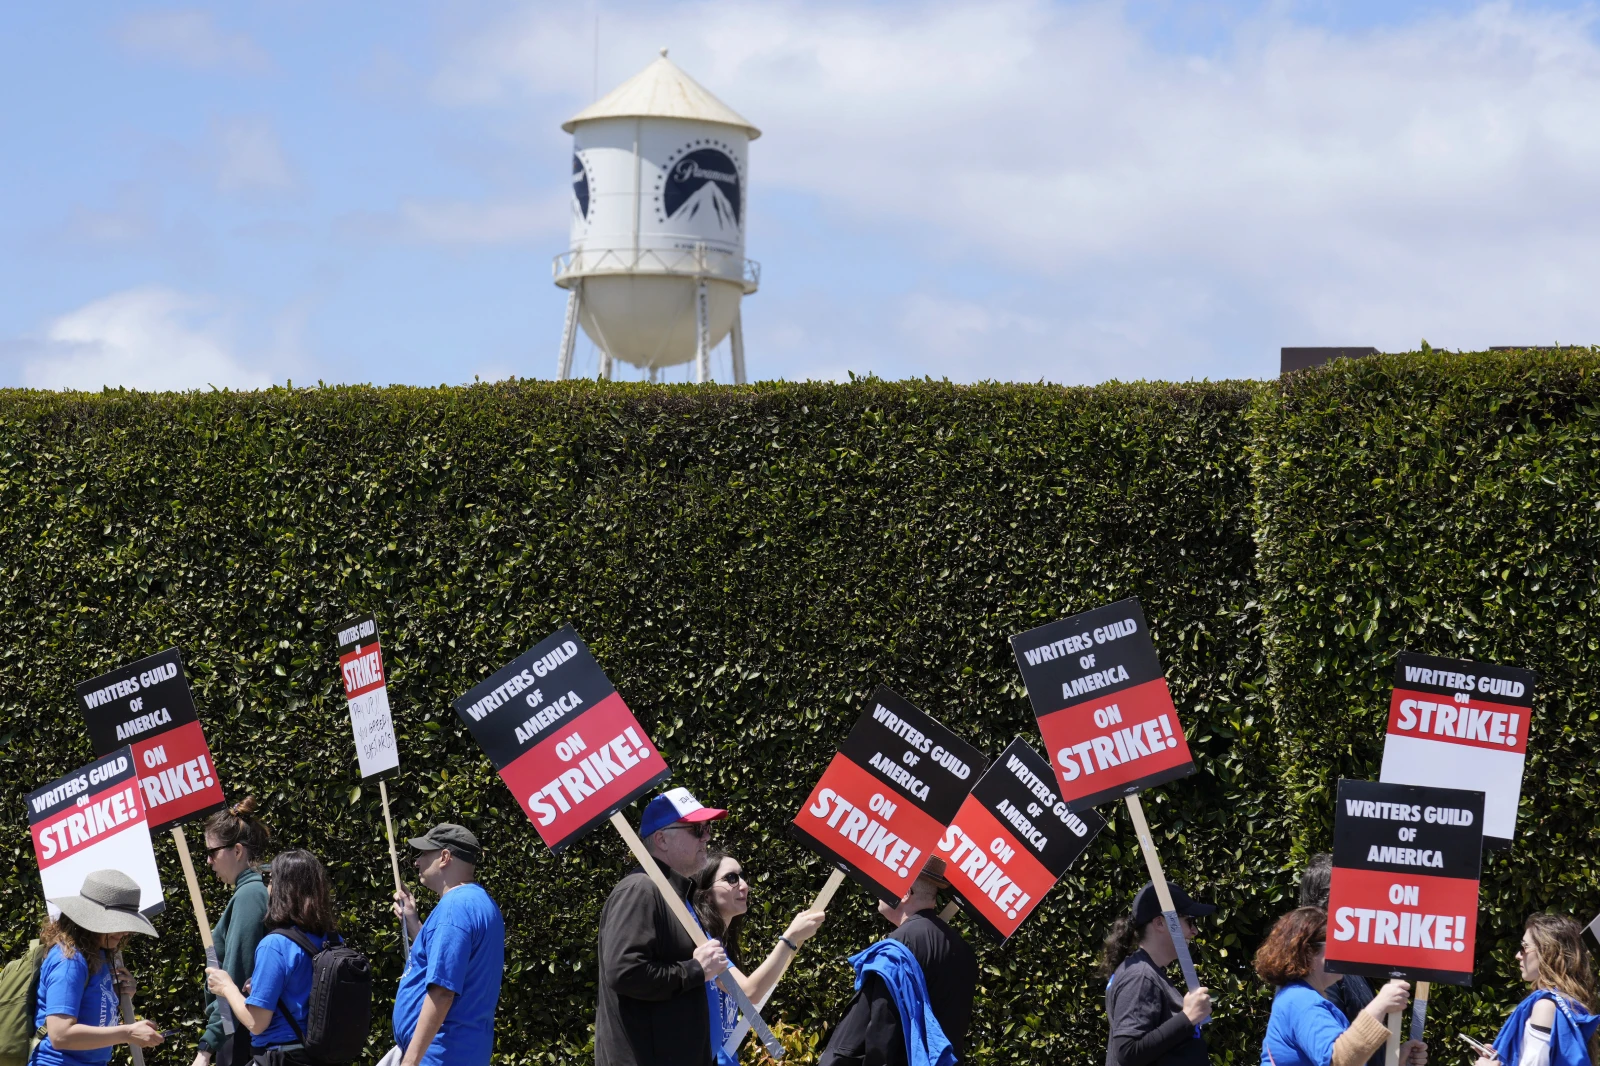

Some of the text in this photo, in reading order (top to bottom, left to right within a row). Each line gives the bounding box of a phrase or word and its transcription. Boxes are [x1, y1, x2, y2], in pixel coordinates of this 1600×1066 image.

[338, 620, 375, 646] WRITERS GUILD
[1024, 618, 1138, 667] WRITERS GUILD
[343, 651, 381, 692] STRIKE!
[1079, 653, 1096, 670] OF
[83, 662, 177, 709] WRITERS GUILD
[466, 640, 578, 722] WRITERS GUILD
[526, 689, 544, 708] OF
[1062, 664, 1130, 700] AMERICA
[1405, 665, 1525, 698] WRITERS GUILD
[1454, 692, 1470, 704] ON
[130, 697, 143, 712] OF
[514, 690, 583, 745] AMERICA
[1093, 703, 1123, 729] ON
[116, 707, 172, 741] AMERICA
[1397, 698, 1520, 747] STRIKE!
[144, 745, 167, 768] ON
[555, 731, 587, 762] ON
[872, 703, 971, 780] WRITERS GUILD
[902, 750, 920, 768] OF
[1057, 713, 1178, 782] STRIKE!
[32, 756, 128, 813] WRITERS GUILD
[139, 754, 214, 811] RIKE!
[528, 725, 651, 827] STRIKE!
[868, 751, 931, 802] AMERICA
[77, 794, 89, 807] ON
[869, 793, 898, 821] ON
[1005, 753, 1088, 838] WRITERS GUILD
[1026, 802, 1044, 818] OF
[1345, 799, 1474, 827] WRITERS GUILD
[40, 787, 138, 860] STRIKE!
[809, 787, 922, 878] STRIKE!
[996, 798, 1048, 853] AMERICA
[1398, 827, 1417, 842] OF
[989, 837, 1015, 865] ON
[1367, 845, 1444, 869] AMERICA
[937, 824, 1031, 920] STRIKE!
[1388, 883, 1420, 907] ON
[1333, 906, 1466, 953] STRIKE!
